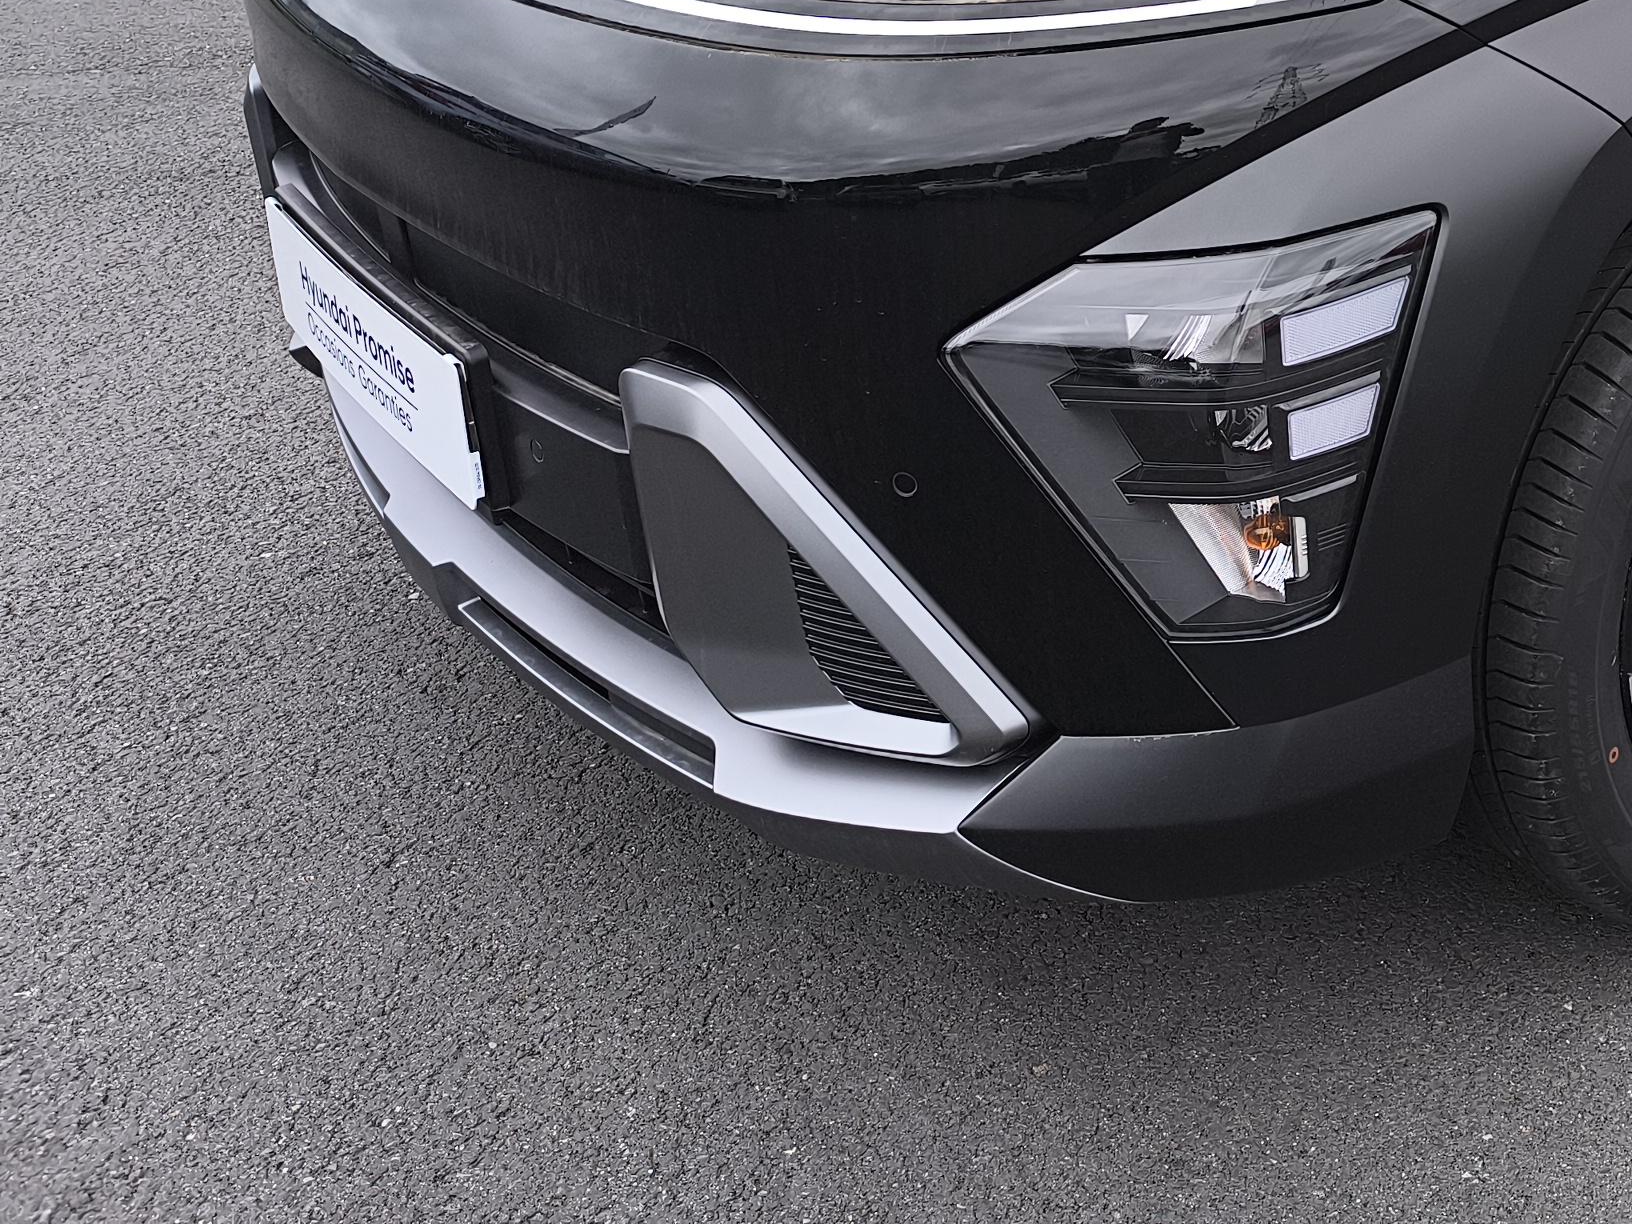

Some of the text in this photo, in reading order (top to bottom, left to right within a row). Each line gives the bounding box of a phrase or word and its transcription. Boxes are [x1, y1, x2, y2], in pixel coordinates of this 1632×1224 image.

[299, 261, 415, 393] Hyundai Promise
[307, 312, 413, 432] Occasions Garanties
